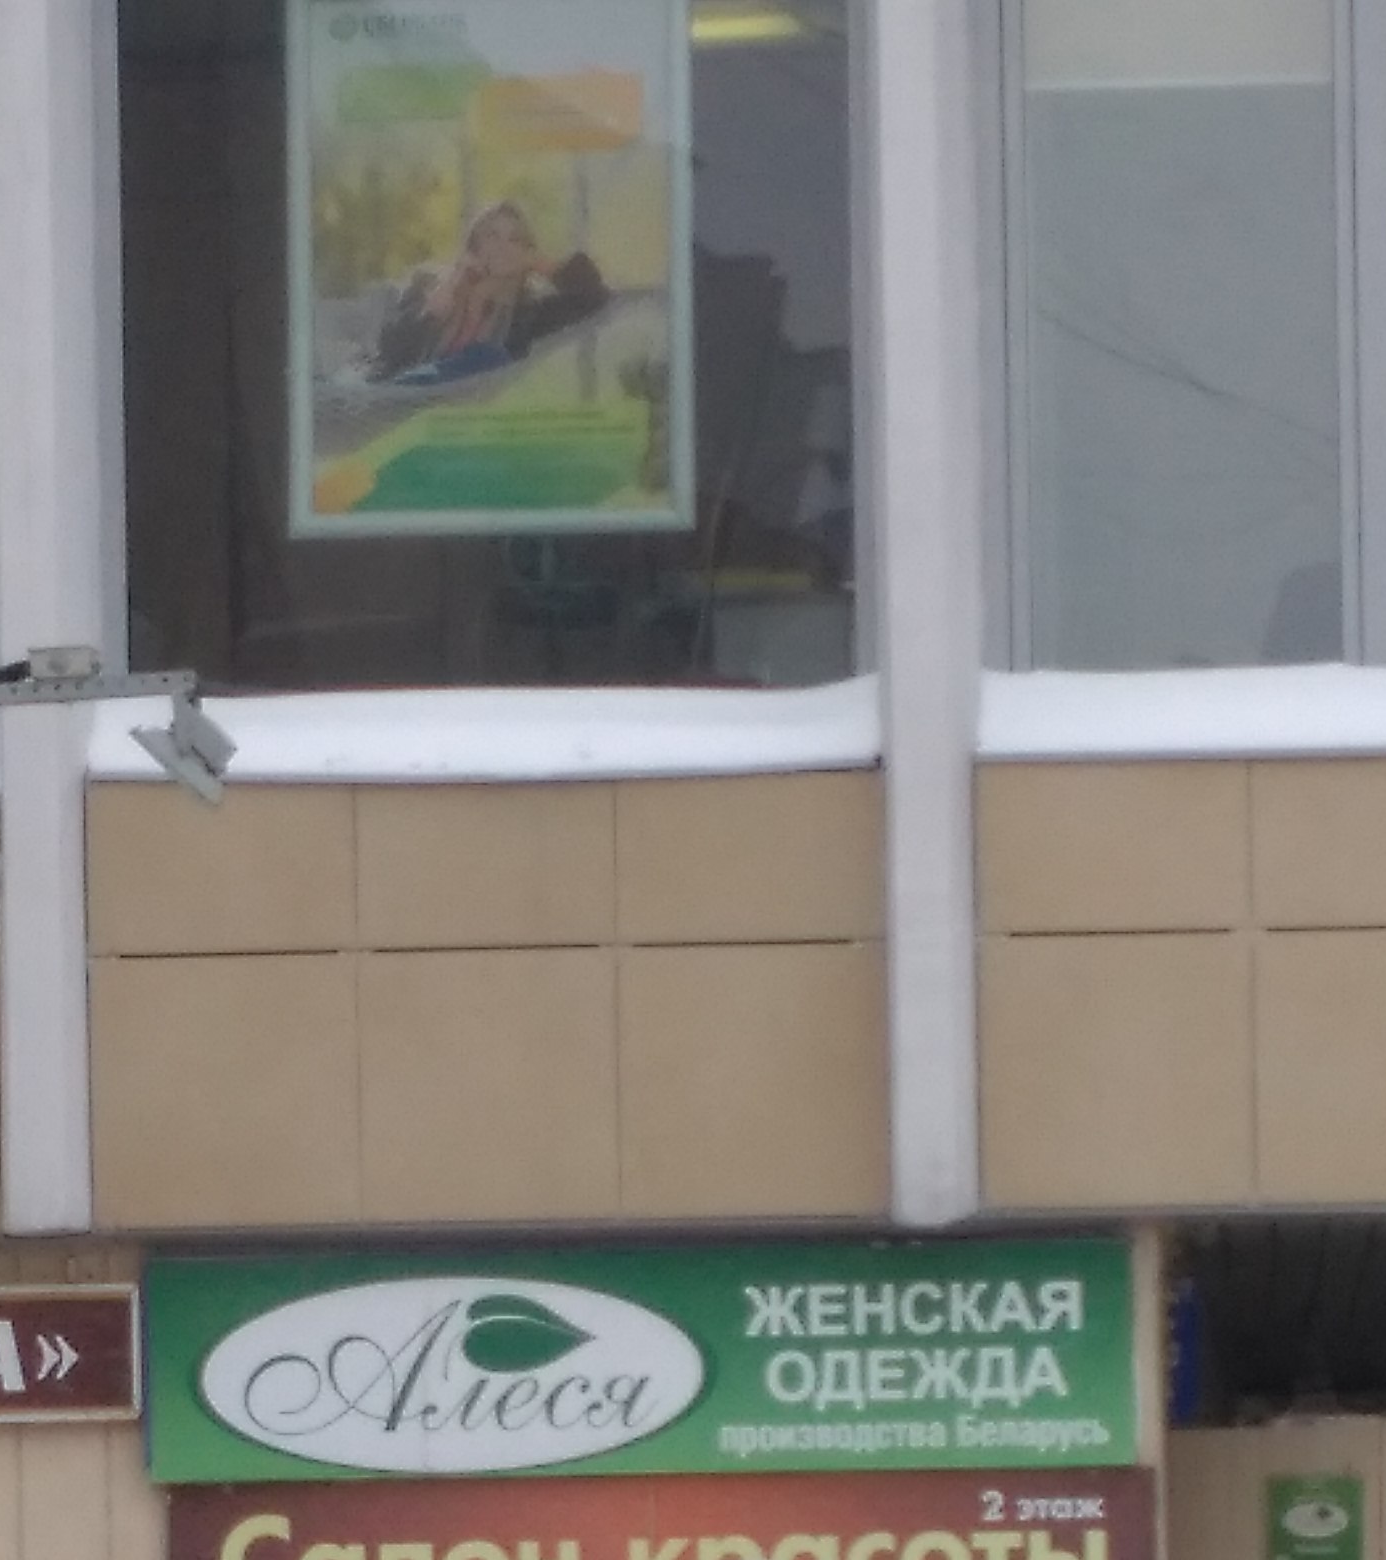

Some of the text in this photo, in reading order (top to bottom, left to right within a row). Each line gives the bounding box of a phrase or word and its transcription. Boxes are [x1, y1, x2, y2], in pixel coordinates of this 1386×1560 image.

[744, 1280, 1084, 1337] ЖЕНСКАЯ
[244, 1299, 651, 1436] Алеся
[765, 1346, 1068, 1411] ОДЕЖДА
[718, 1414, 1111, 1458] производства Беларусь
[982, 1490, 1104, 1520] 2 этаж
